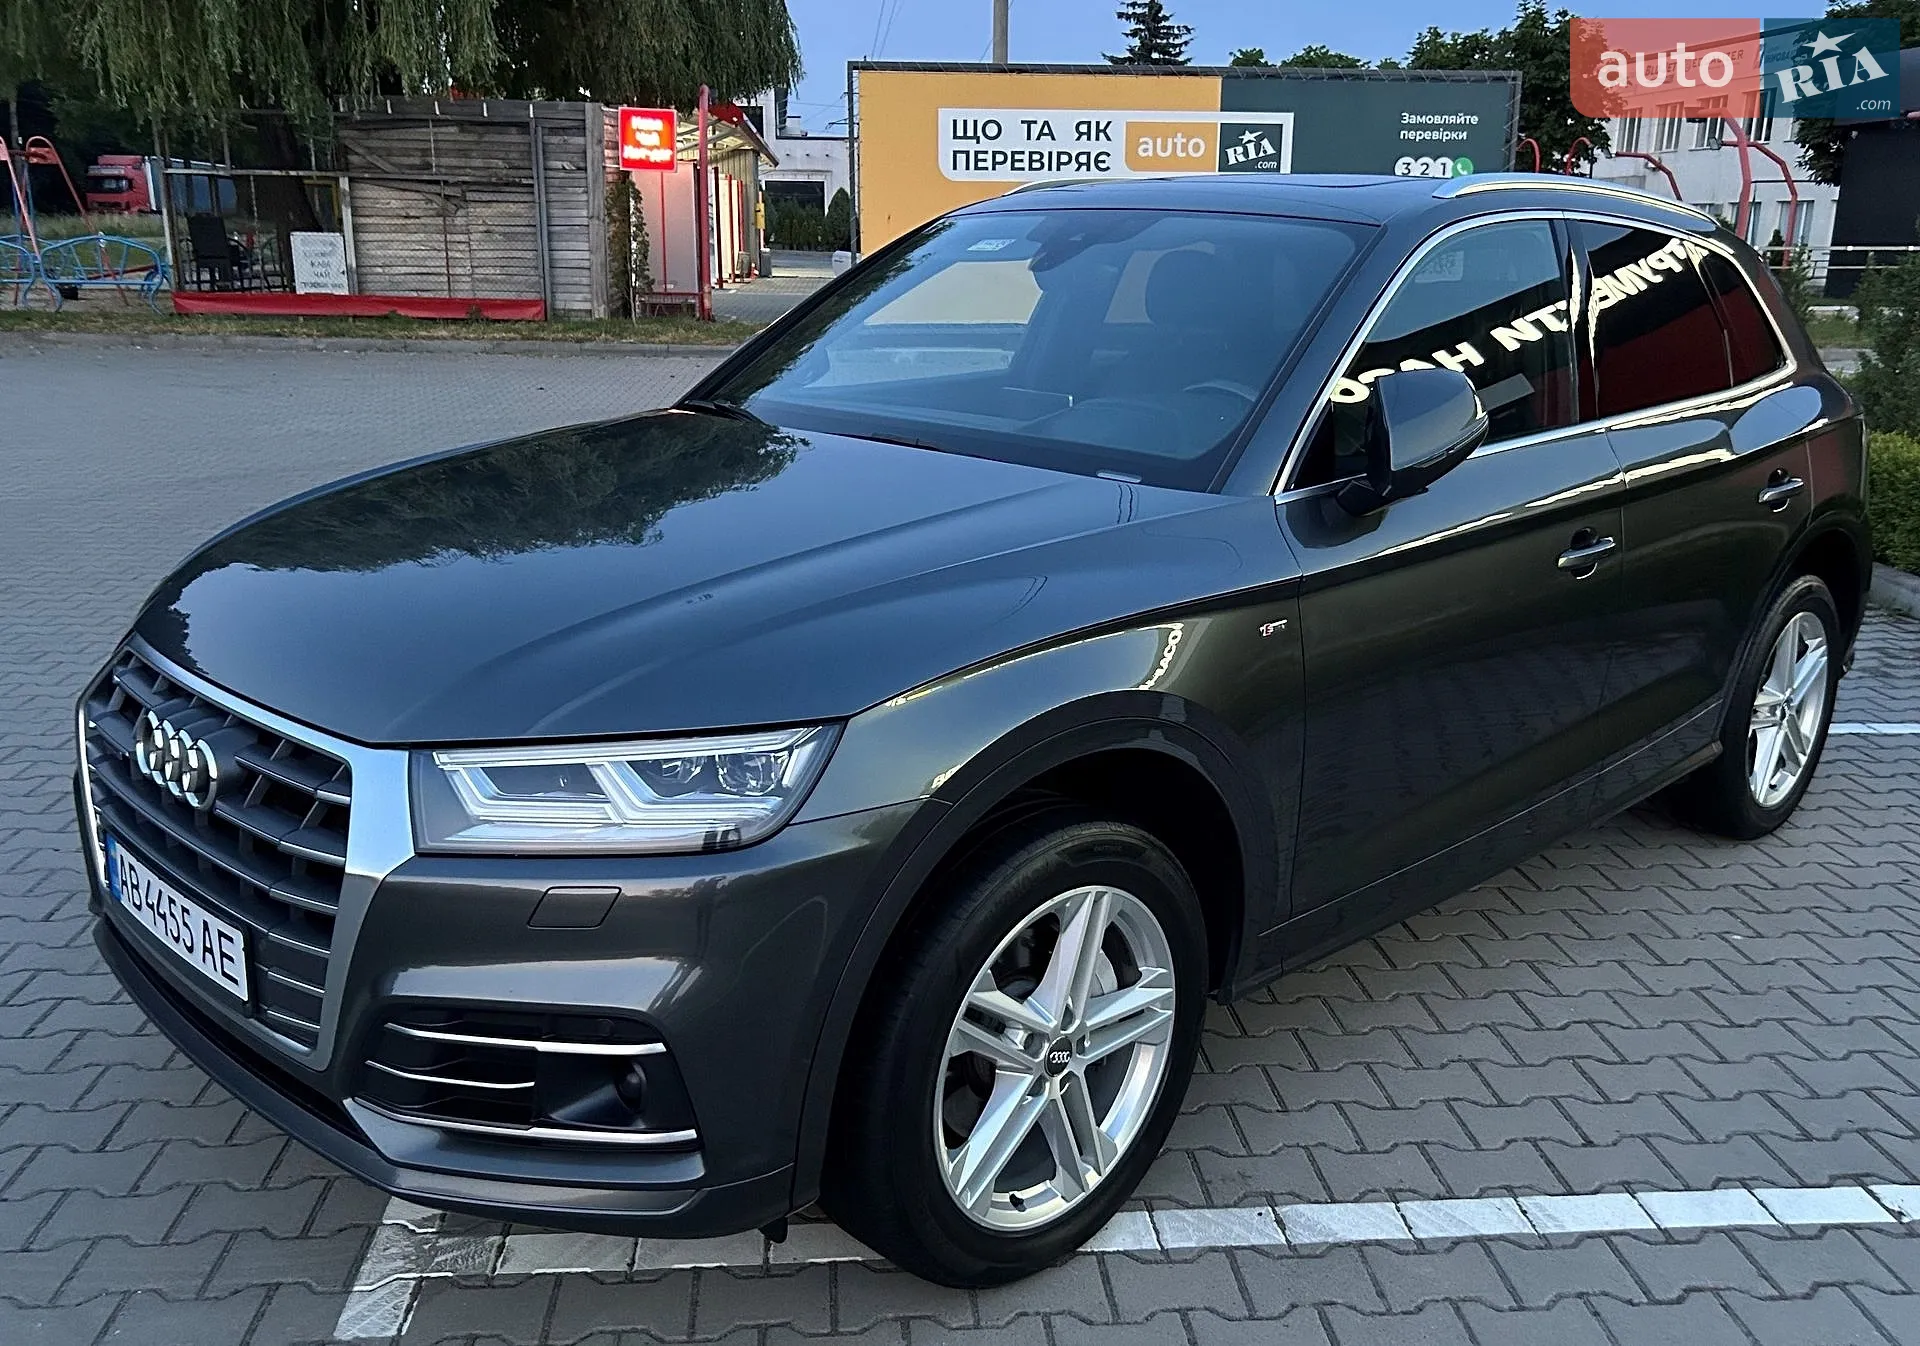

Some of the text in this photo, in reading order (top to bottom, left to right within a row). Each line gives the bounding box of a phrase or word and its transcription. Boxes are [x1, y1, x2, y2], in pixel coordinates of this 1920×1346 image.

[1401, 112, 1479, 125] Замовляйте
[952, 119, 1112, 144] ЩО ТА ЯК
[1400, 128, 1468, 142] перевірки
[1136, 132, 1277, 166] auto RIA
[952, 150, 1112, 172] ПЕРЕВІРЯЄ
[1255, 159, 1278, 169] .com
[120, 854, 240, 986] AB 4455 AE
